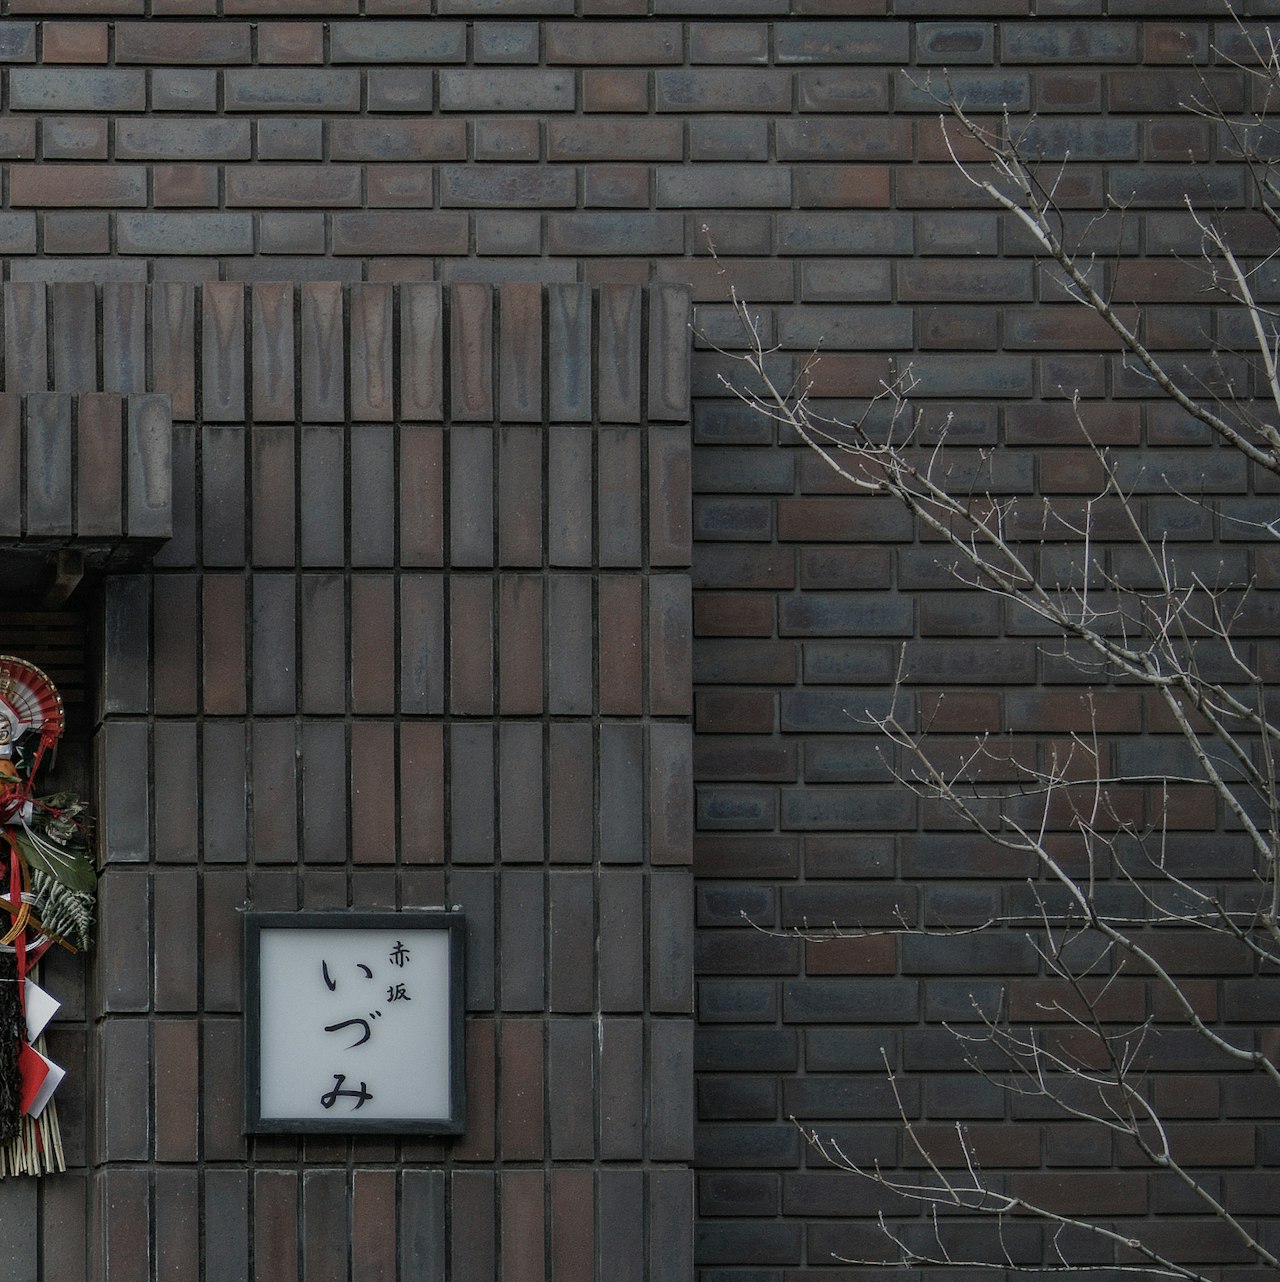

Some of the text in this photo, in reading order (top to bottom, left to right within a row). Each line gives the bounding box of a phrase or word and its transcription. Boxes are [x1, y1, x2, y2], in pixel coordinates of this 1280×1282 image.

[386, 939, 412, 1003] 赤坂
[320, 959, 382, 1112] いづみ
